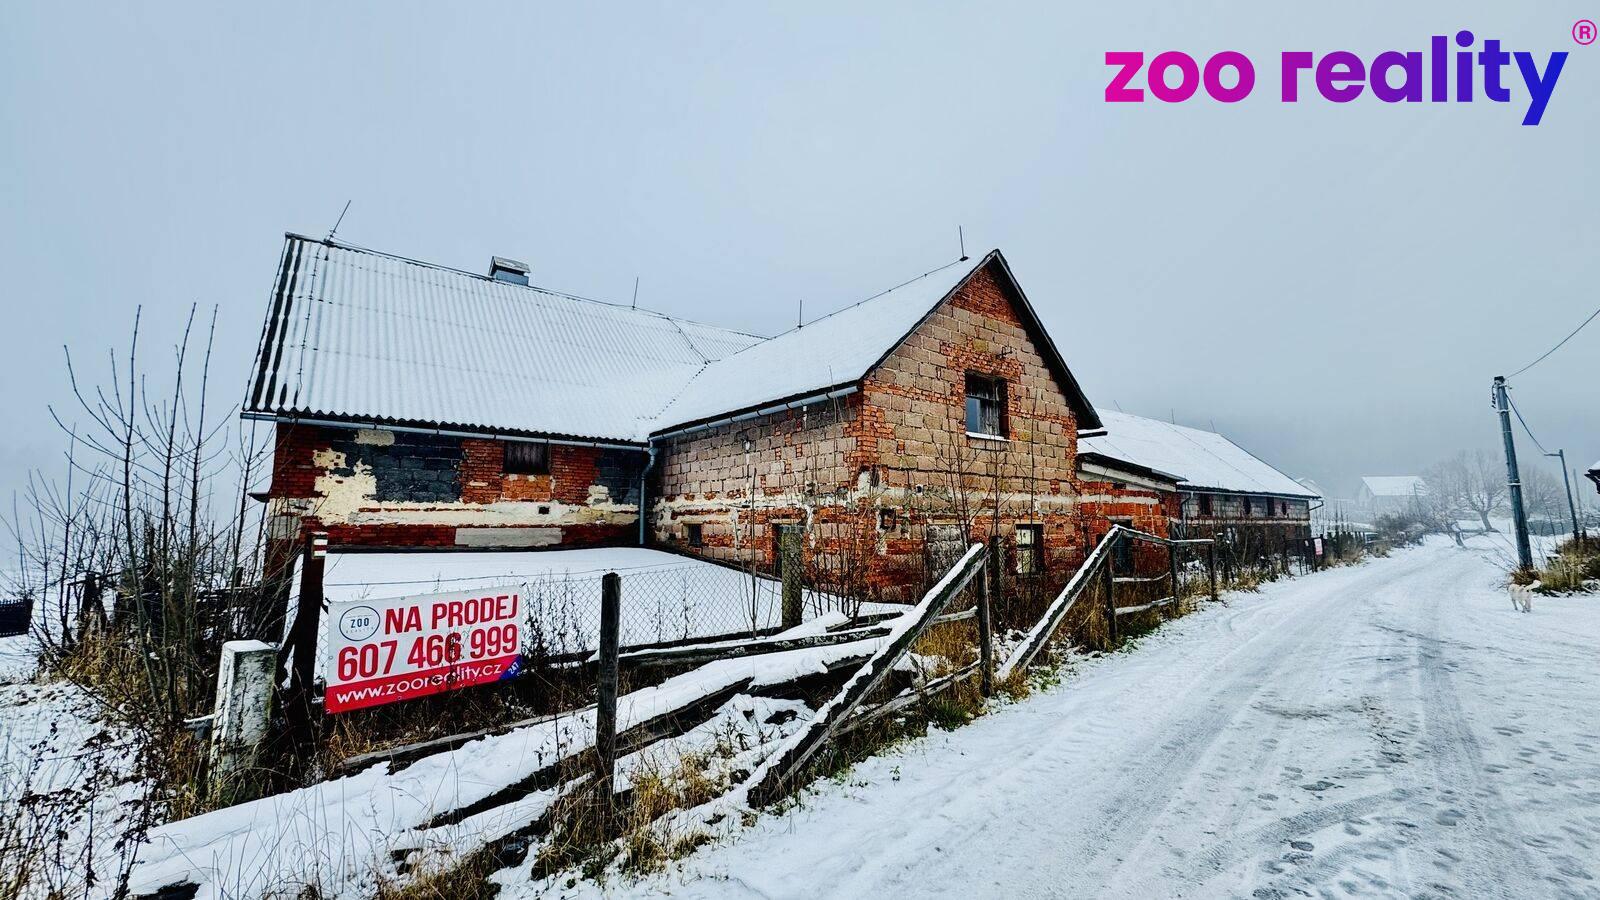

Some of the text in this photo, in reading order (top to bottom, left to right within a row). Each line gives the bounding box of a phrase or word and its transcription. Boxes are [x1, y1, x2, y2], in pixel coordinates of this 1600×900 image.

[350, 618, 369, 629] ZOO
[385, 595, 518, 635] NA PRODEJ
[337, 624, 518, 682] 607 466 999
